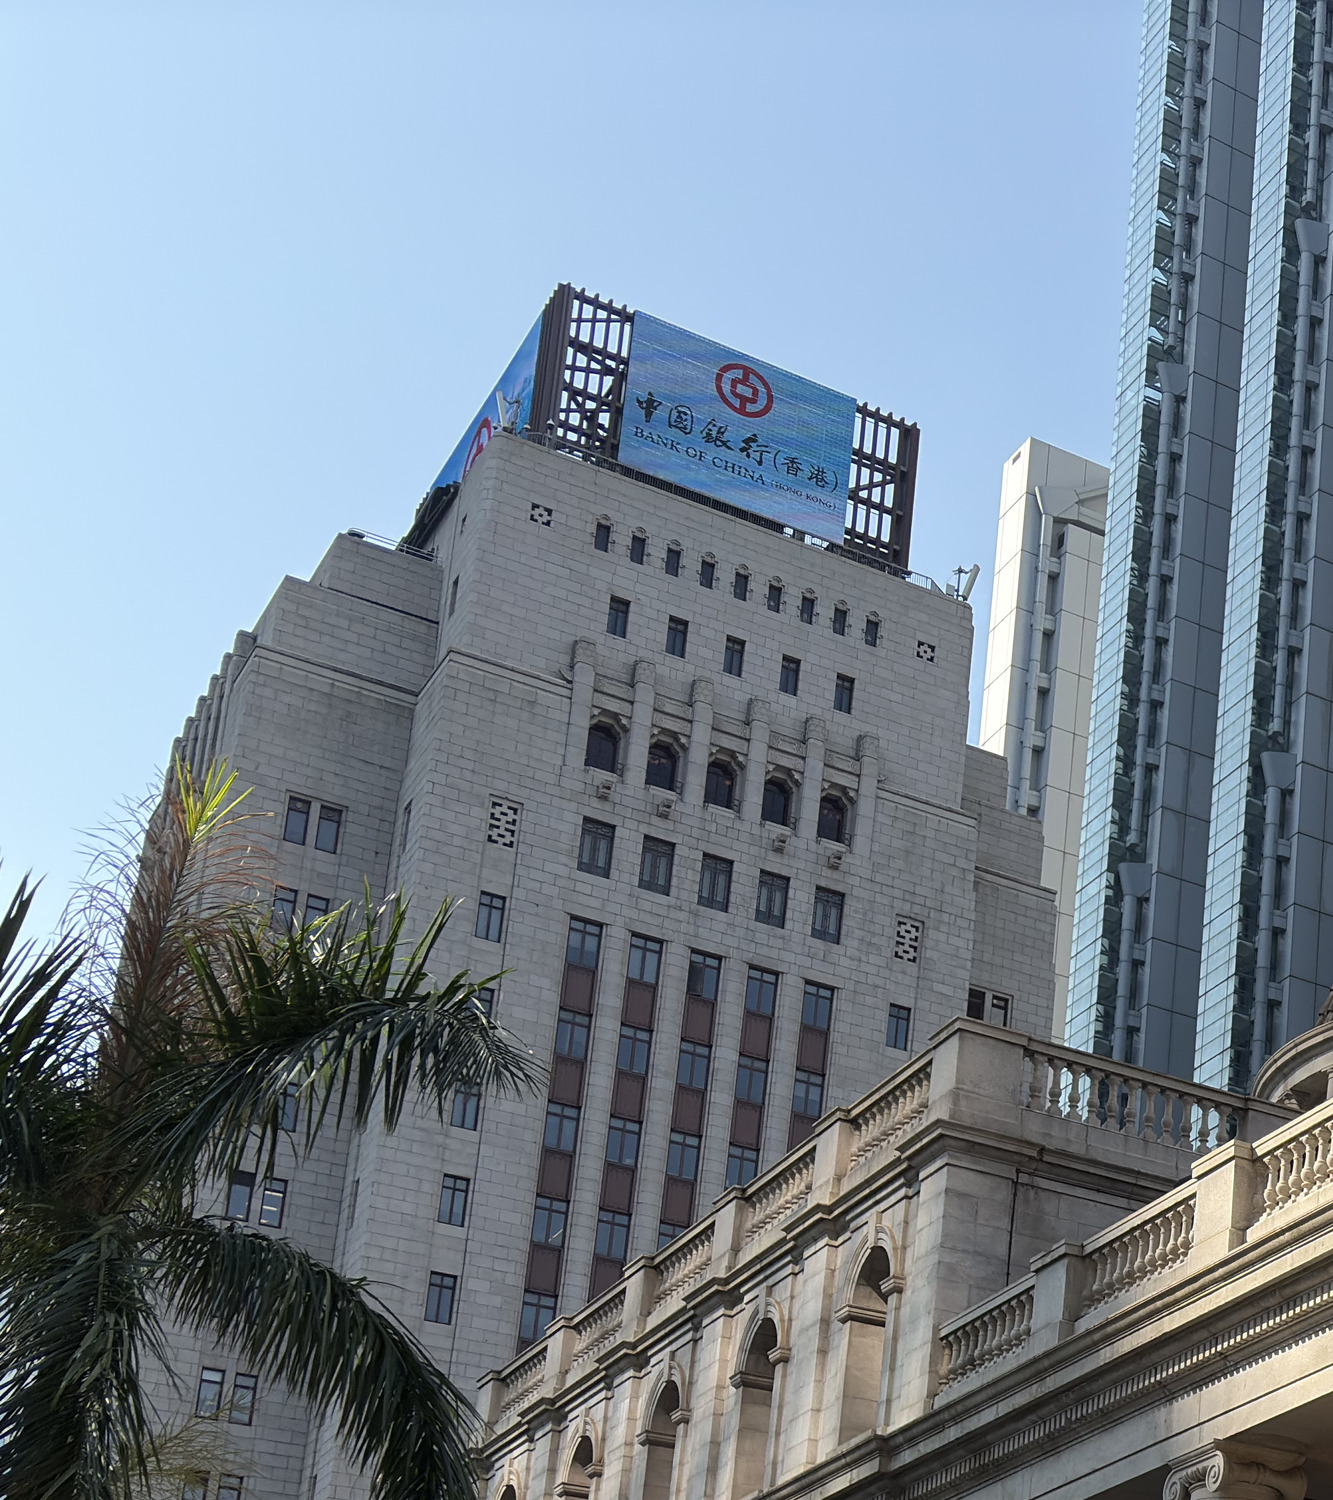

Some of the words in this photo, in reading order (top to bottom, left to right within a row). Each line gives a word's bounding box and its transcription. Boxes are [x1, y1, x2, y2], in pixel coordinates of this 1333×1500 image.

[634, 426, 681, 453] BANK
[685, 446, 708, 462] OF
[712, 456, 767, 485] CHINA
[771, 479, 803, 497] (HONG
[805, 493, 837, 510] KONG)
